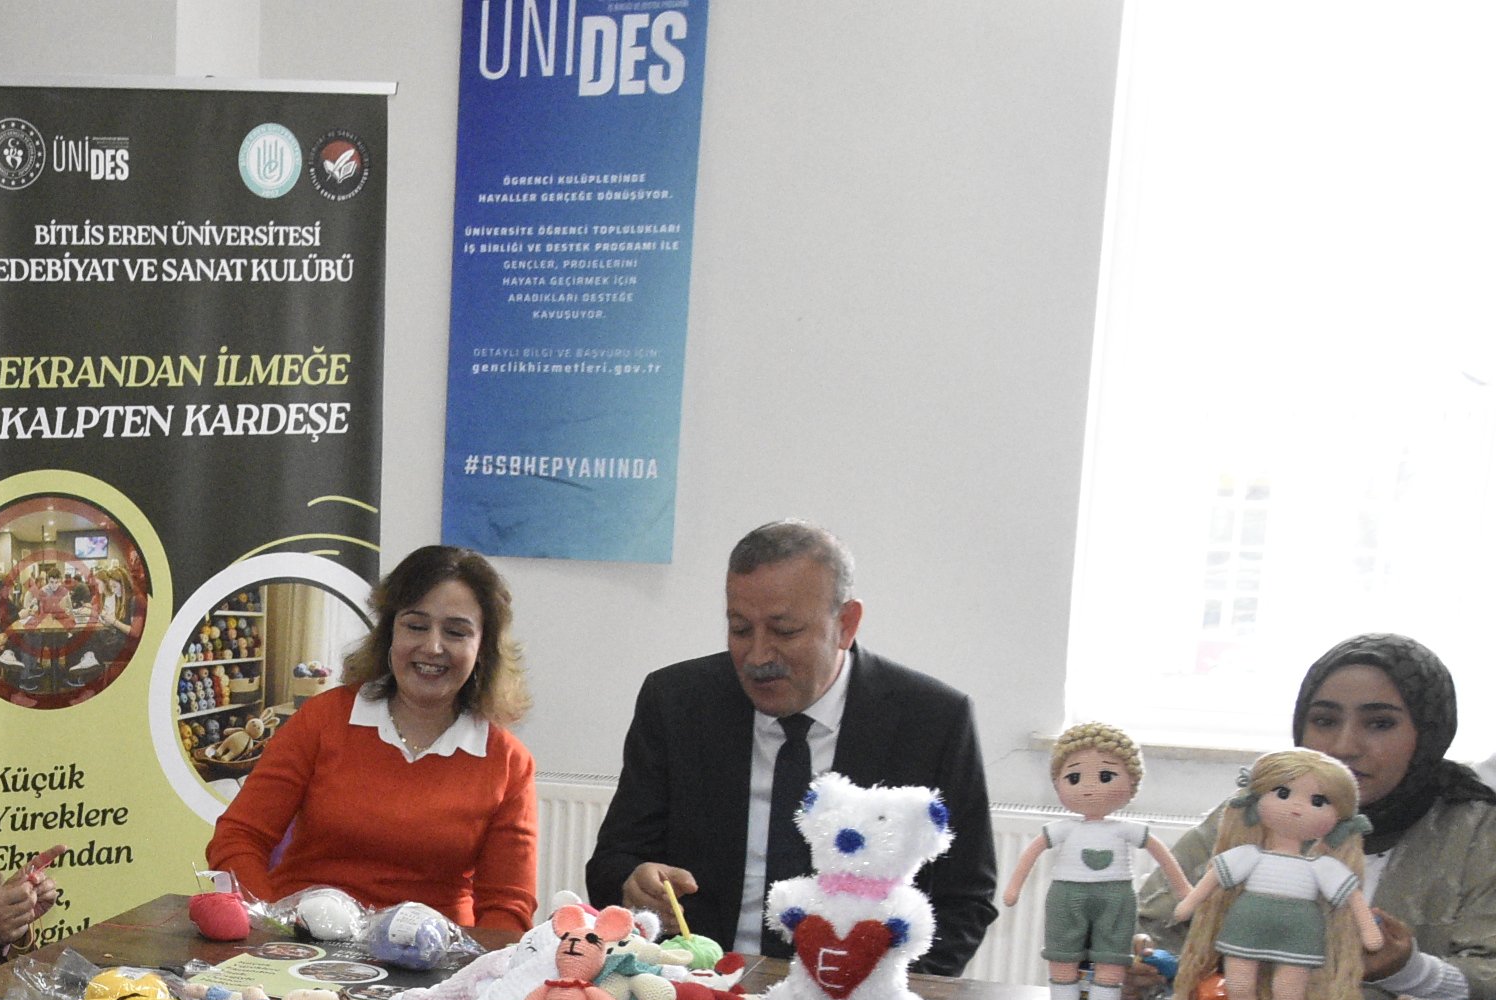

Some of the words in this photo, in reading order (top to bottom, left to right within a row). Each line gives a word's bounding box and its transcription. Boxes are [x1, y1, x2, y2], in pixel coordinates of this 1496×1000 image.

[478, 193, 537, 203] HAYALLER
[541, 191, 593, 204] GERÇEĞE
[597, 189, 673, 201] DÖNÜŞÜYOR.
[34, 219, 104, 246] BİTLİS
[107, 224, 168, 246] EREN
[171, 219, 321, 247] ÜNİVERSİTESİ
[464, 225, 534, 237] ÜNİVERSİTE
[592, 223, 681, 235] TOPLULUKLARI
[527, 242, 541, 253] VE
[546, 242, 590, 253] DESTEK
[594, 241, 656, 252] PROGRAMI
[660, 240, 680, 251] İLE
[122, 258, 158, 282] VE
[161, 258, 248, 282] SANAT
[250, 253, 355, 282] KULÜBÜ
[502, 276, 546, 286] HAYATA
[507, 292, 578, 303] ARADIKLARI
[557, 348, 572, 358] VE
[214, 346, 351, 387] İLMEĞE
[181, 403, 351, 443] KARDEŞE
[463, 454, 659, 479] #GSBHEPYANINDA
[817, 948, 849, 989] E
